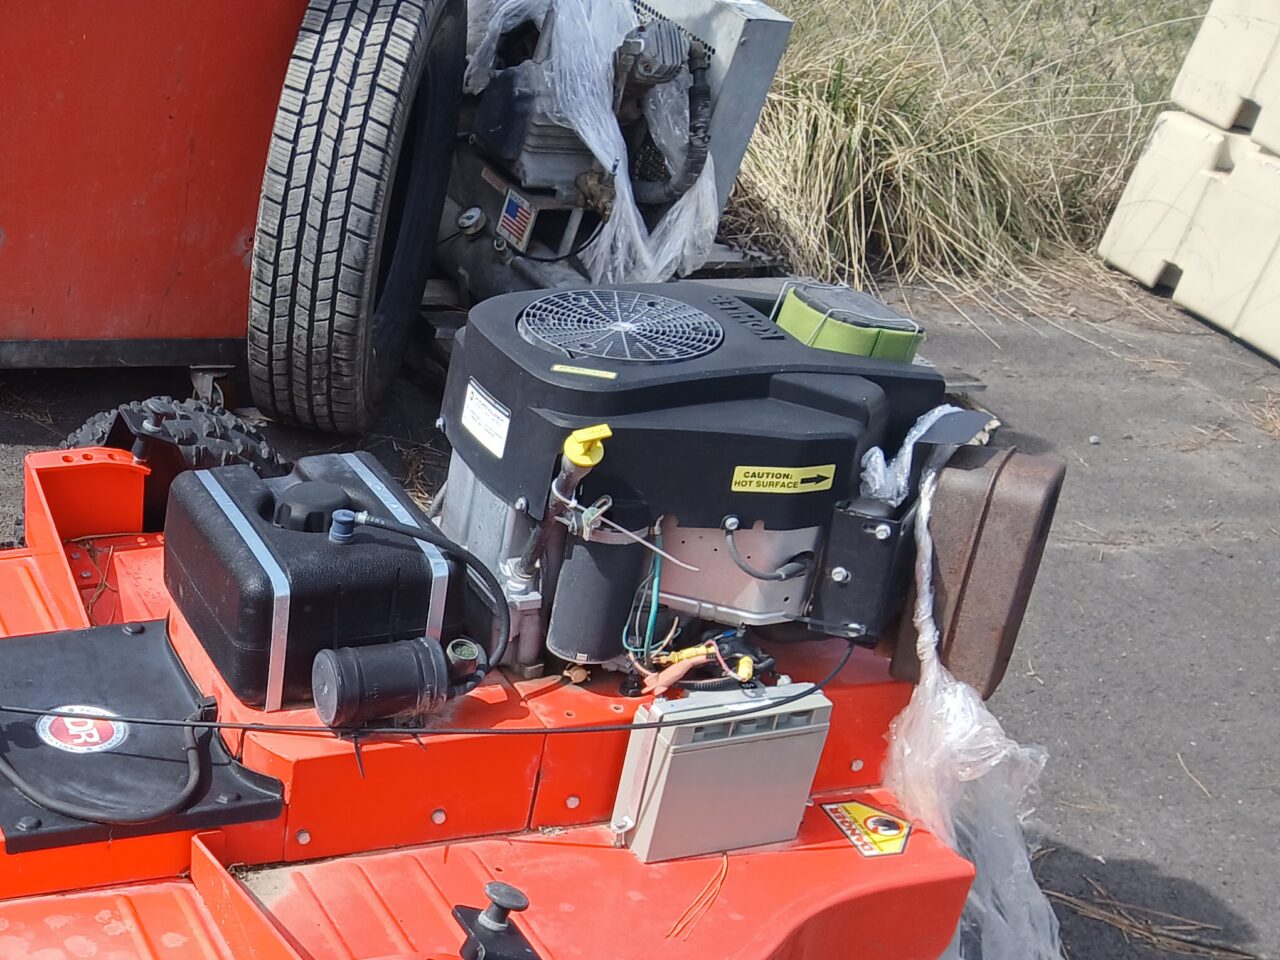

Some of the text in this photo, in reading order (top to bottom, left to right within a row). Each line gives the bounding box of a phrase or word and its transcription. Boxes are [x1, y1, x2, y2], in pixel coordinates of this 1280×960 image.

[734, 480, 799, 489] HOT SURFACE
[829, 807, 873, 851] DANGER
